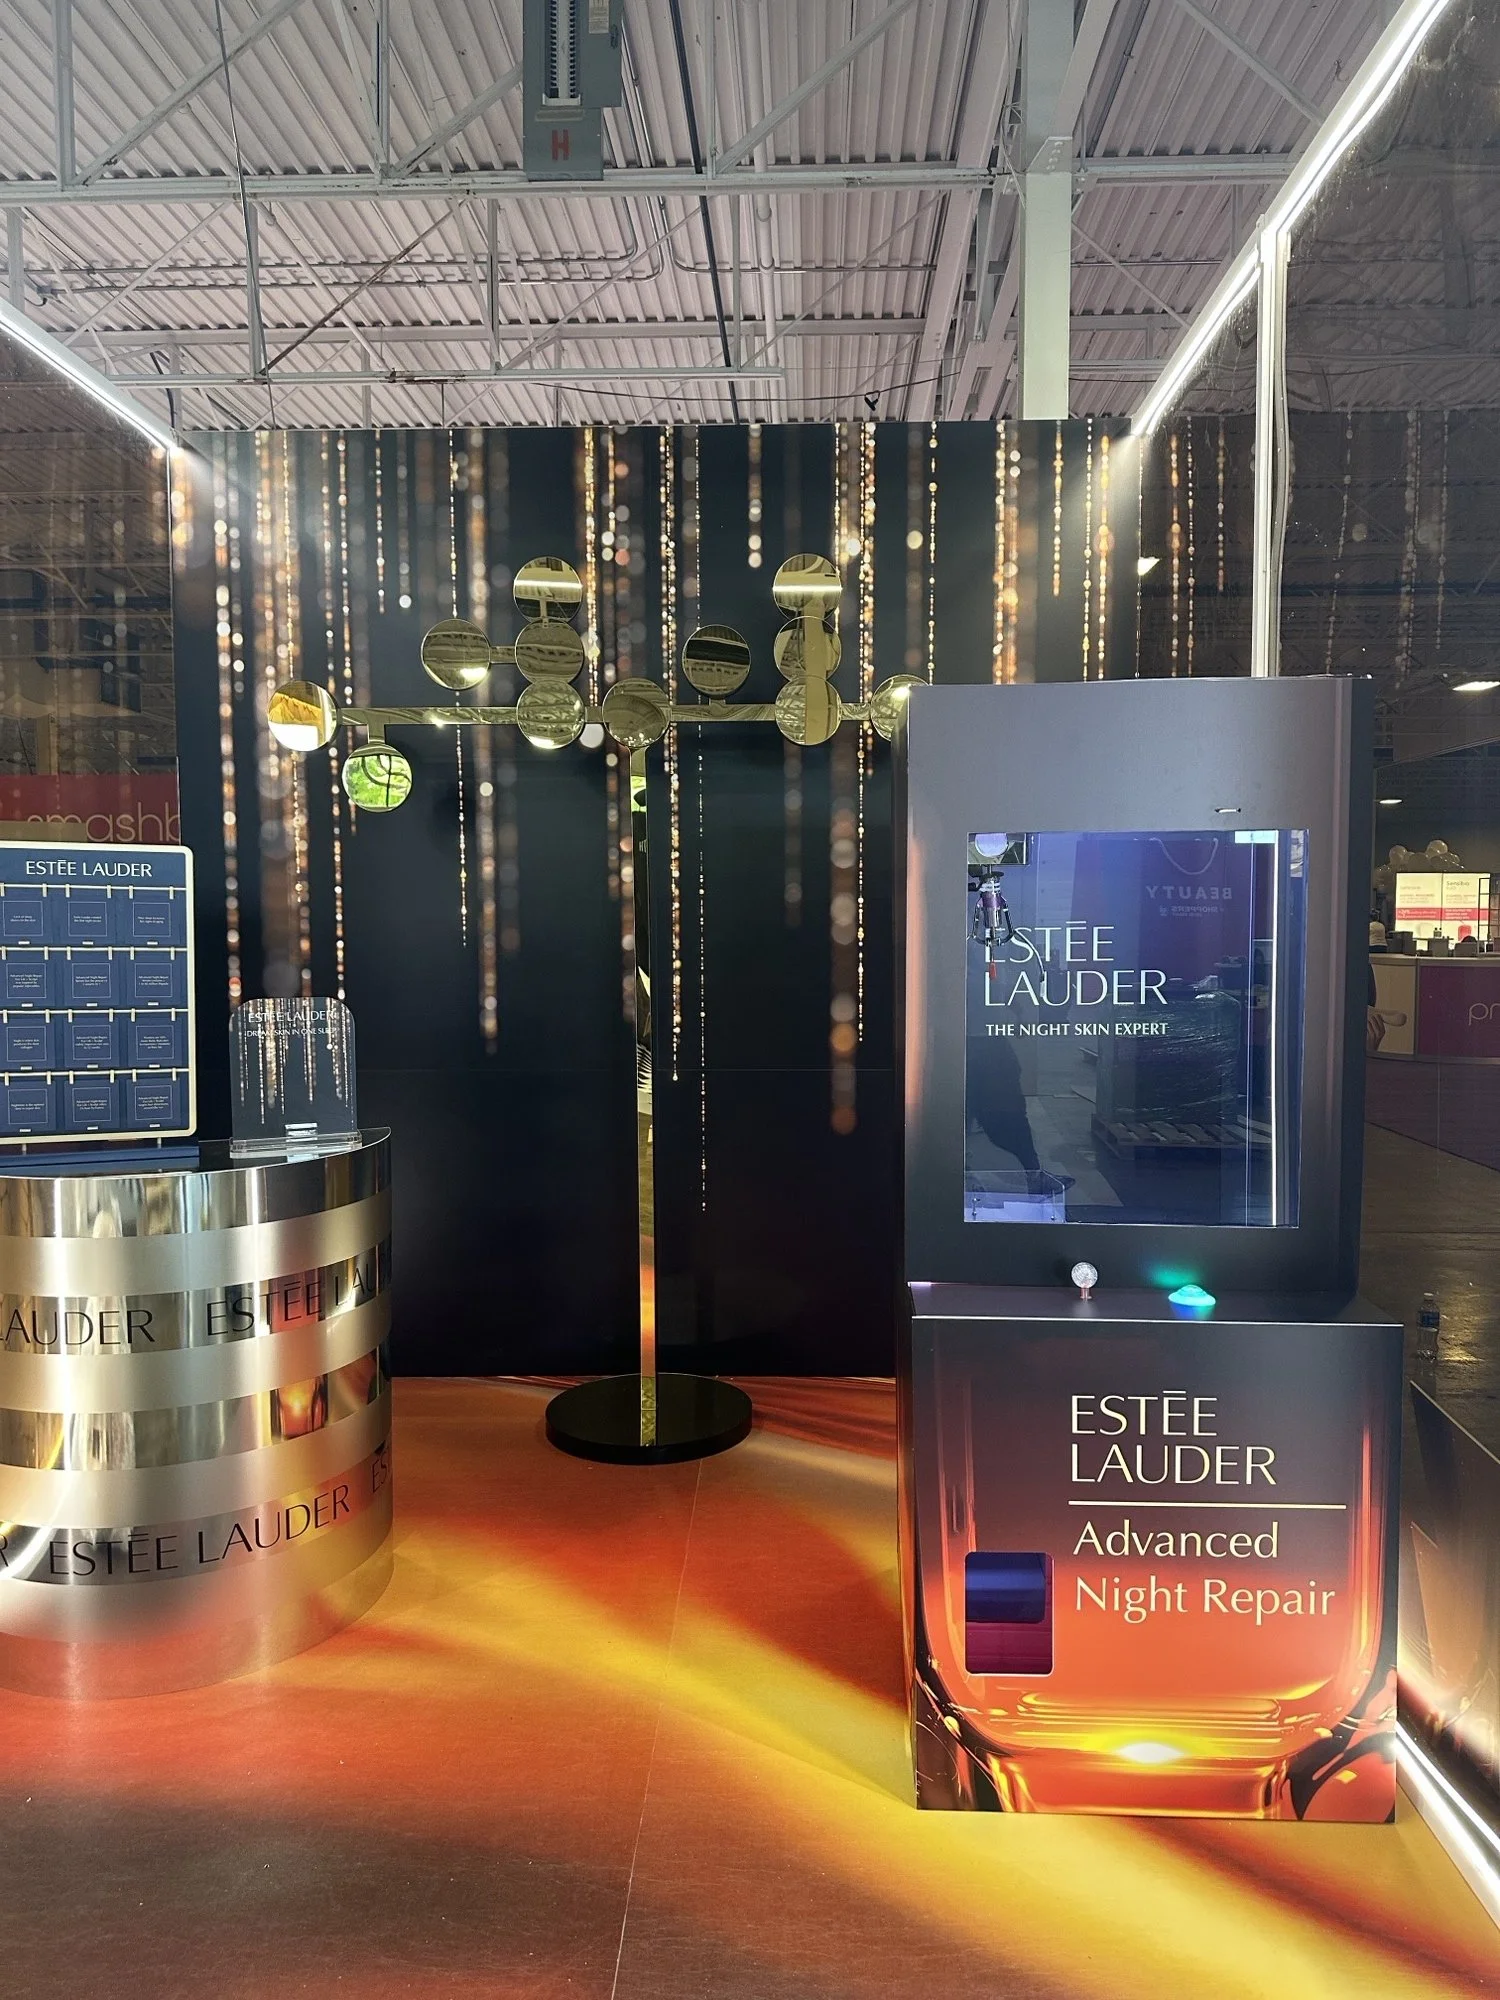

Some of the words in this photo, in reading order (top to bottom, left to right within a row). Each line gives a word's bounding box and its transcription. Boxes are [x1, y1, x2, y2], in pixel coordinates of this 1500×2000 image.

[552, 129, 570, 161] H
[82, 861, 153, 878] LAUDER
[984, 969, 1168, 1006] LAUDER
[985, 1023, 1014, 1036] THE
[1019, 1023, 1070, 1036] NIGHT
[1074, 1022, 1110, 1036] SKIN
[1115, 1022, 1168, 1035] EXPERT
[0, 1308, 156, 1346] AUDER
[1071, 1443, 1277, 1485] LAUDER
[198, 1484, 350, 1564] LAUDER
[1073, 1519, 1279, 1558] Advanced
[1076, 1575, 1188, 1624] Night
[1203, 1578, 1335, 1626] Repair
